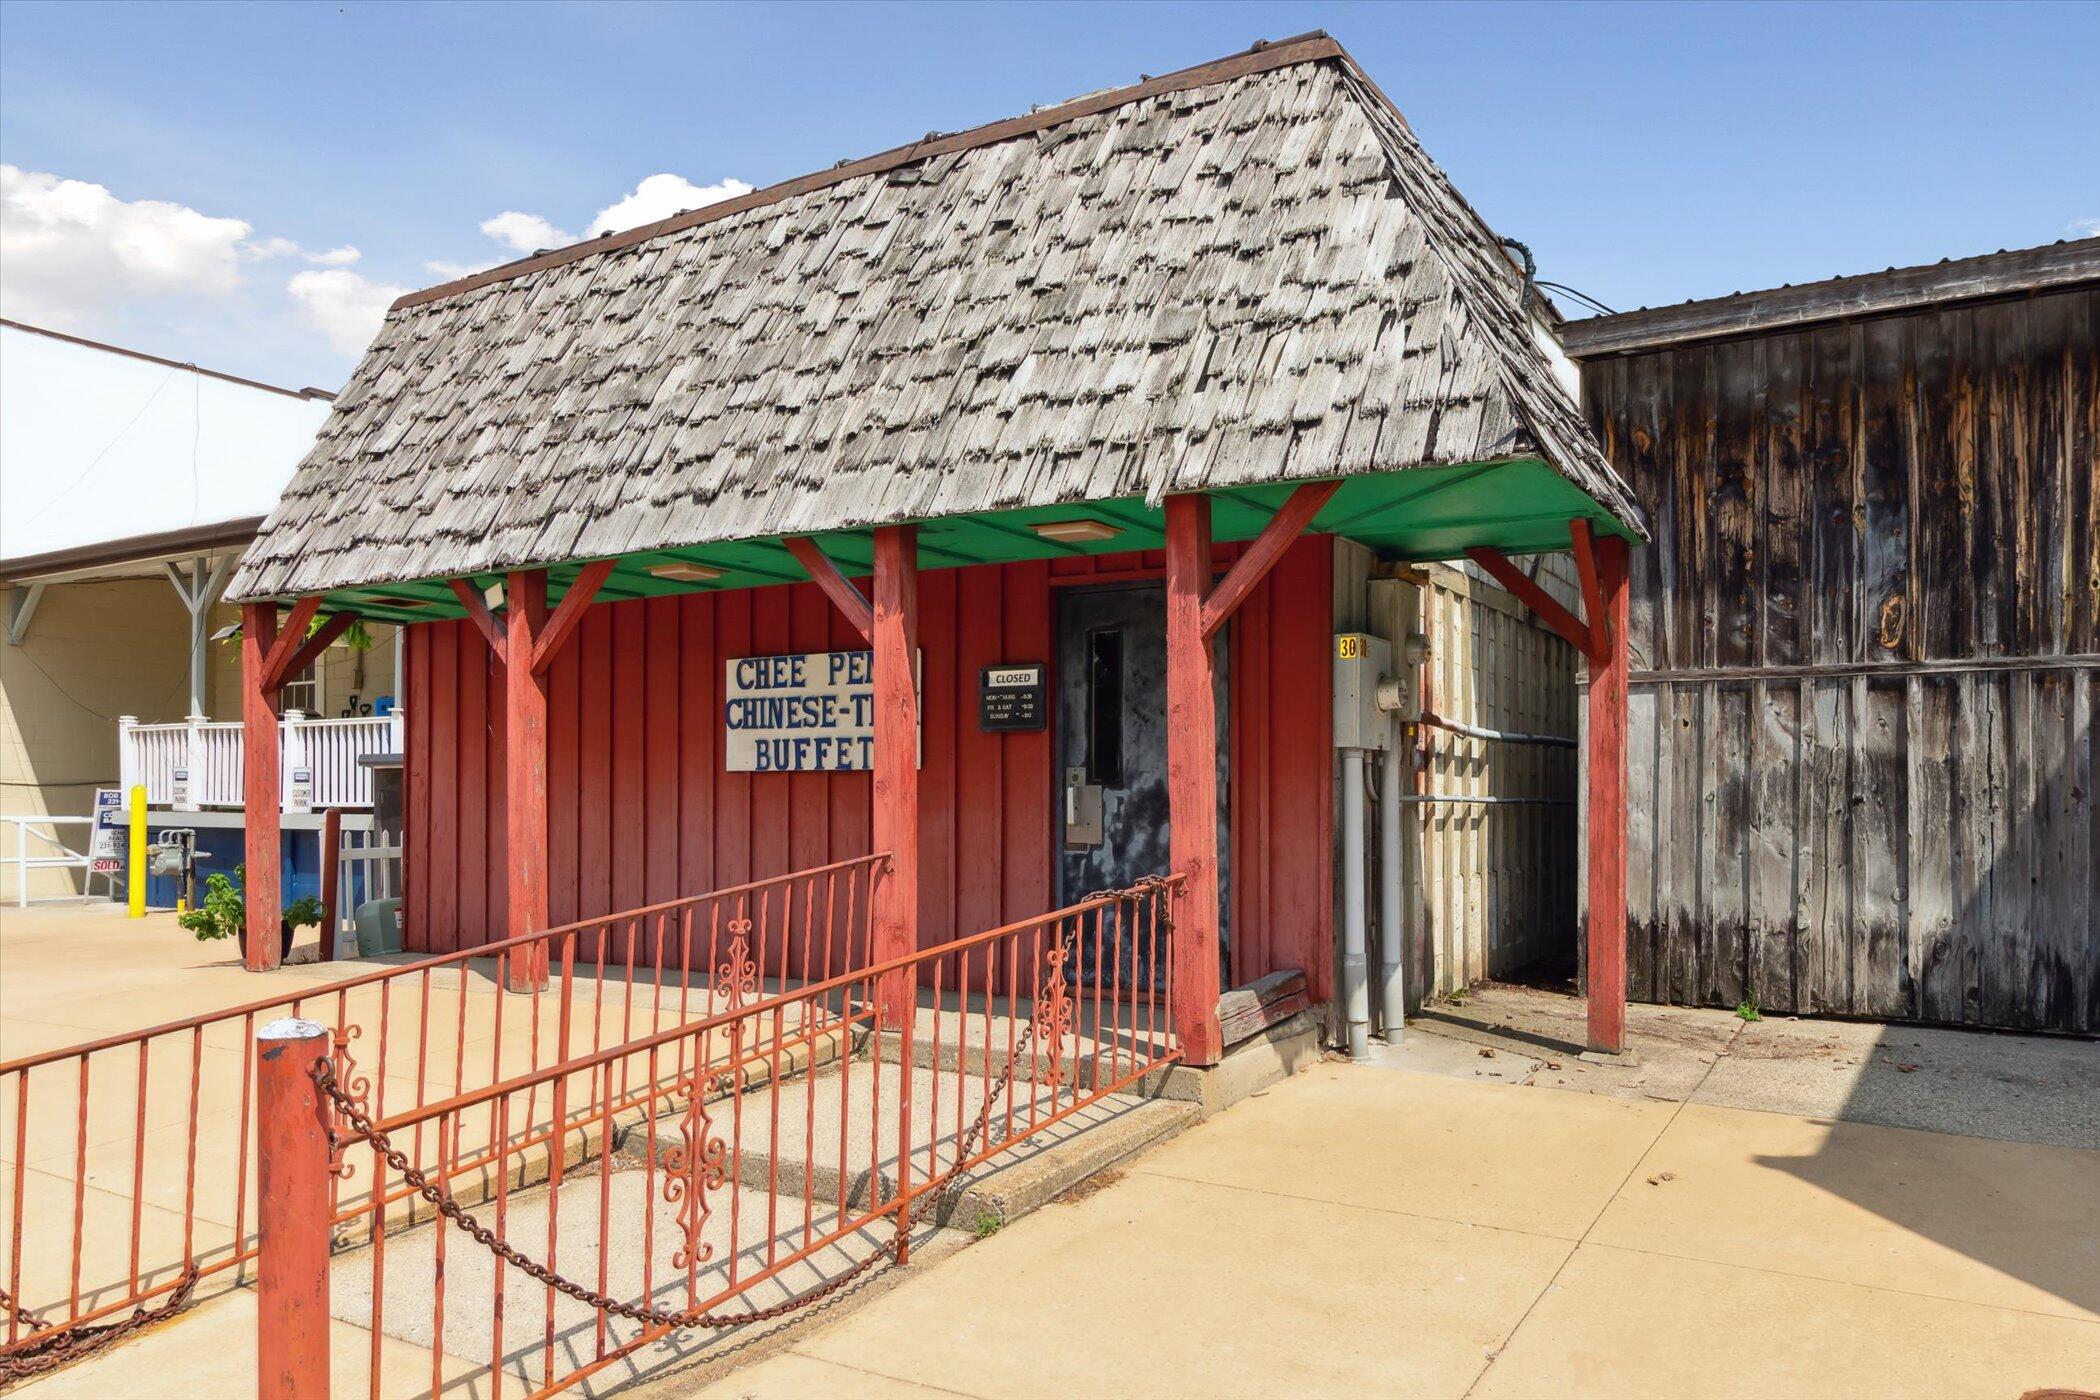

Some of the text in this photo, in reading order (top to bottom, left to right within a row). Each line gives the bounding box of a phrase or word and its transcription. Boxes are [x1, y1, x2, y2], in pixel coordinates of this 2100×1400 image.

[1341, 638, 1357, 657] 30
[736, 655, 807, 690] CHEE
[996, 673, 1031, 684] CLOSED
[754, 736, 875, 771] BUFFET
[94, 860, 120, 871] SOLD
